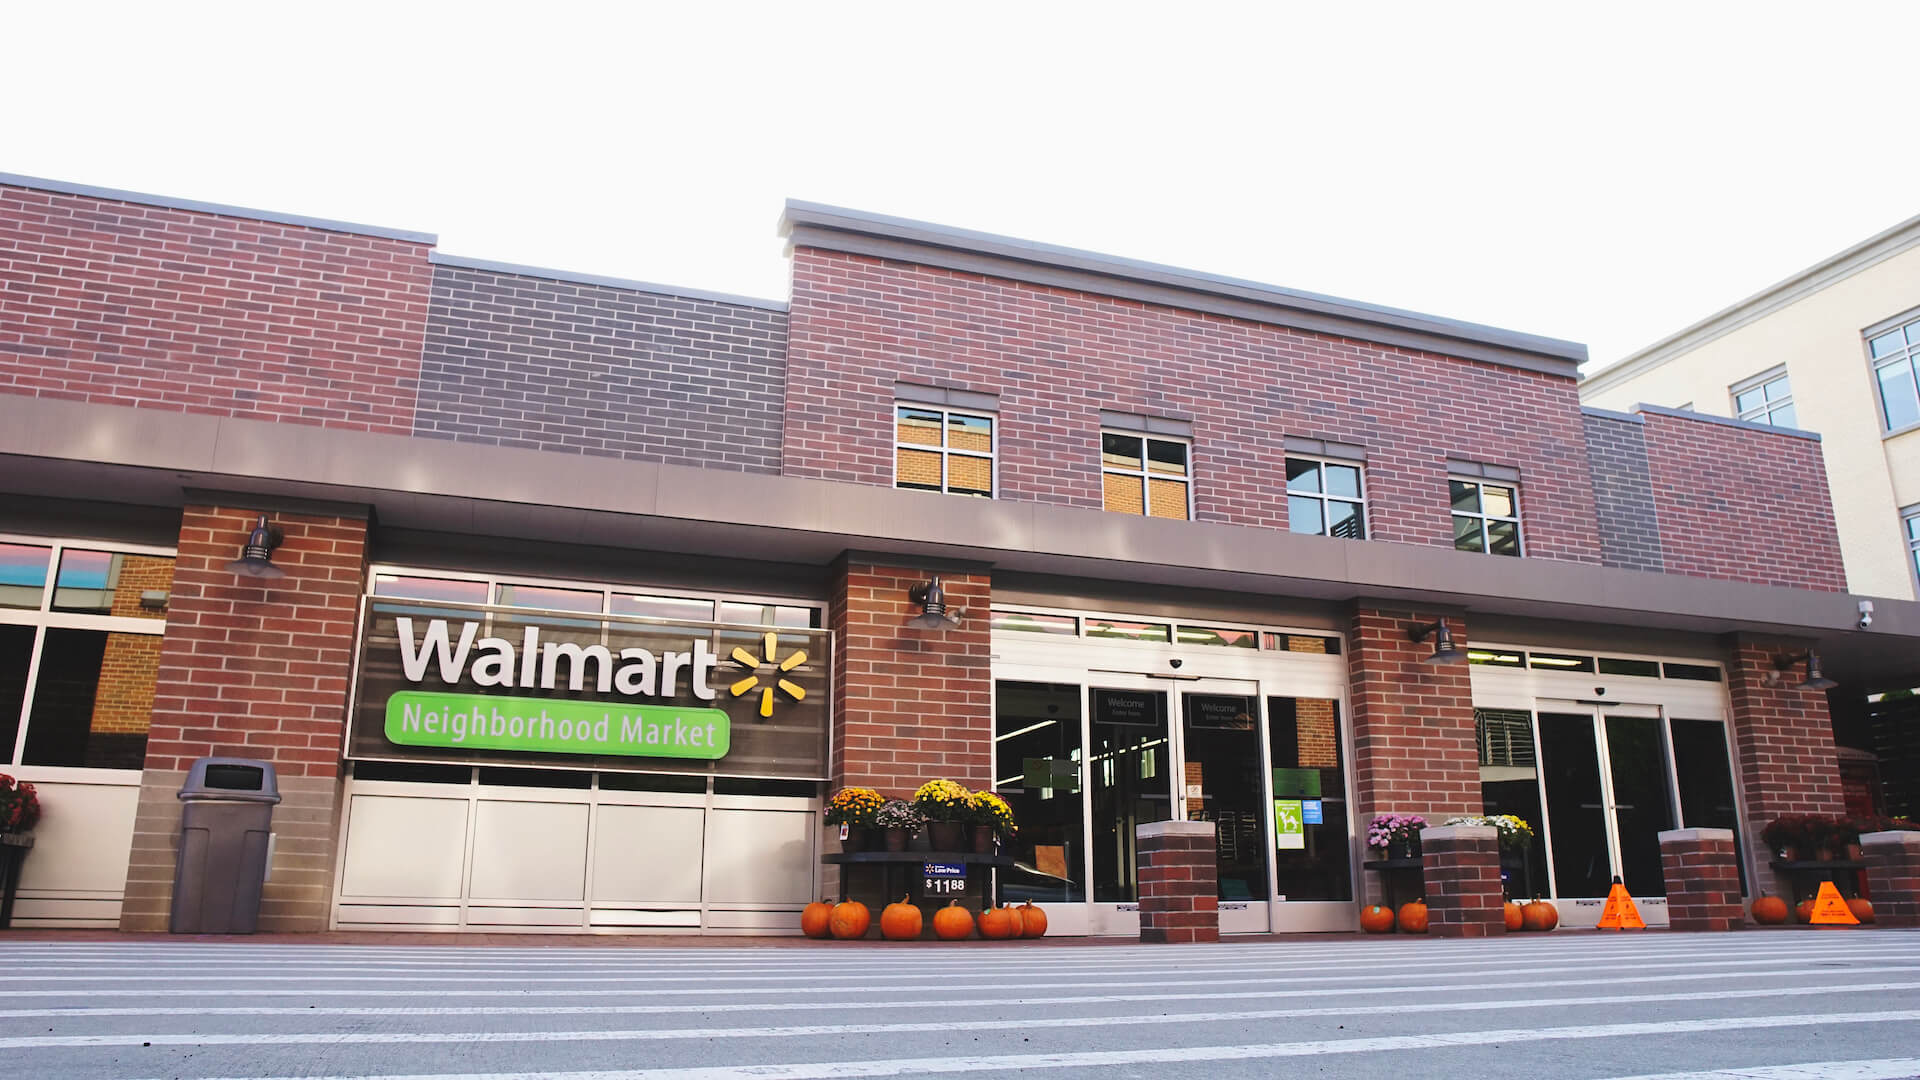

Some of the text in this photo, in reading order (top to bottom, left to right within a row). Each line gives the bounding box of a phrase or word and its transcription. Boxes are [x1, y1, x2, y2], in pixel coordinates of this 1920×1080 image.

[395, 616, 718, 701] Walmart
[1107, 697, 1145, 709] Welcome
[1200, 703, 1237, 713] Welcome
[401, 703, 717, 749] Neighborhood Market
